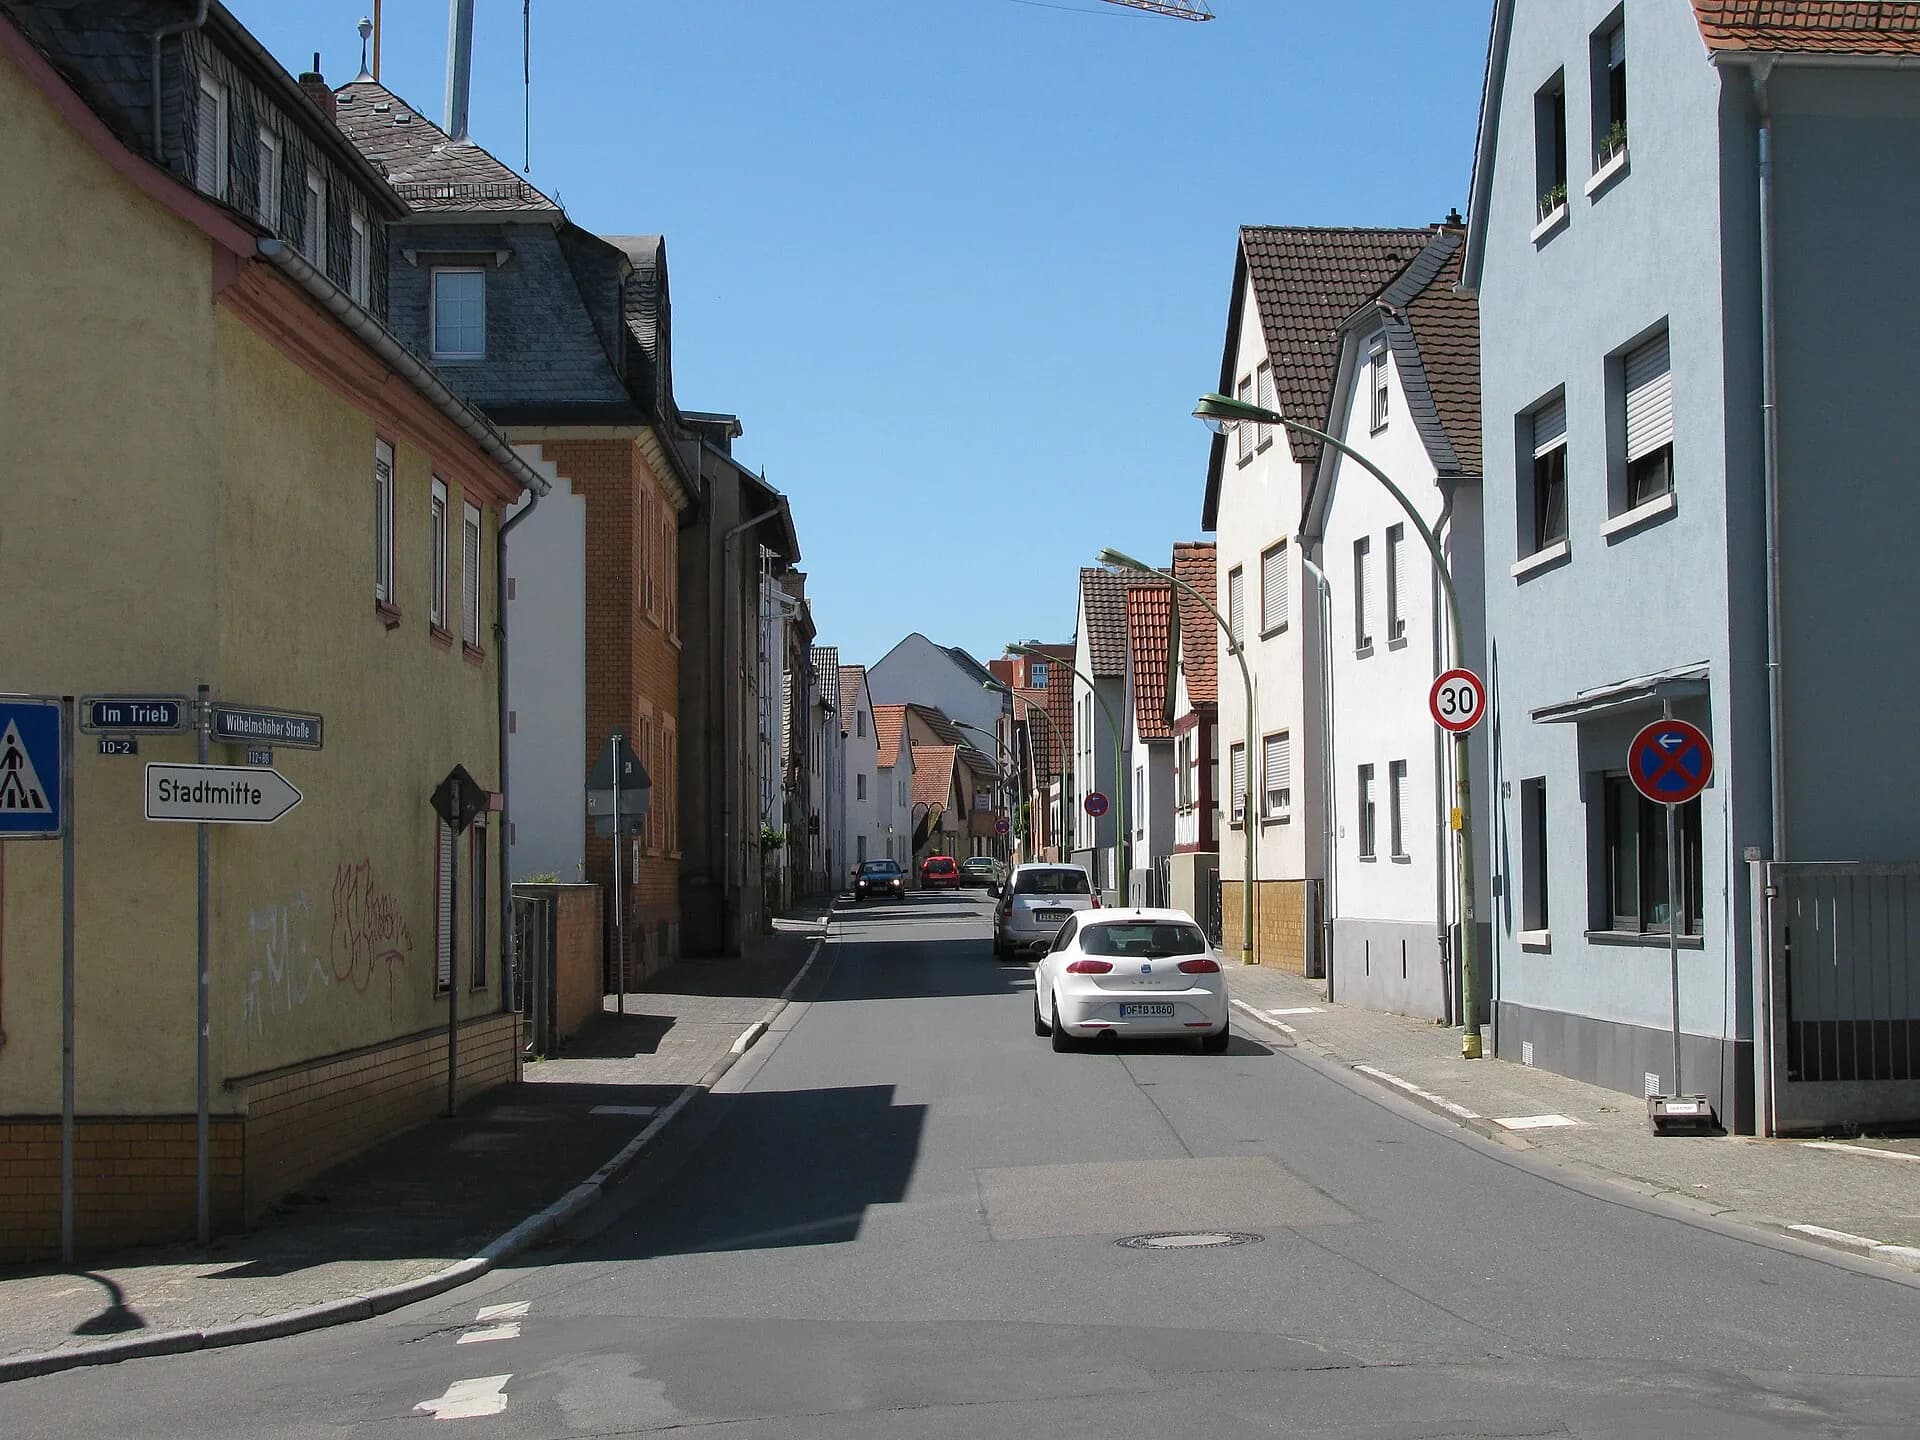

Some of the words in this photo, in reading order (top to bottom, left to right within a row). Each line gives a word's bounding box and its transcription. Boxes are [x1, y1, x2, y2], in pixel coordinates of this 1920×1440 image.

[1441, 686, 1473, 715] 30
[102, 705, 121, 722] Im
[130, 705, 169, 722] Trieb
[226, 714, 284, 736] Wilhelmshöher
[285, 720, 310, 738] Straße
[101, 741, 130, 753] 10-2
[159, 778, 262, 805] Stadtmitte
[1151, 1005, 1172, 1015] 1860
